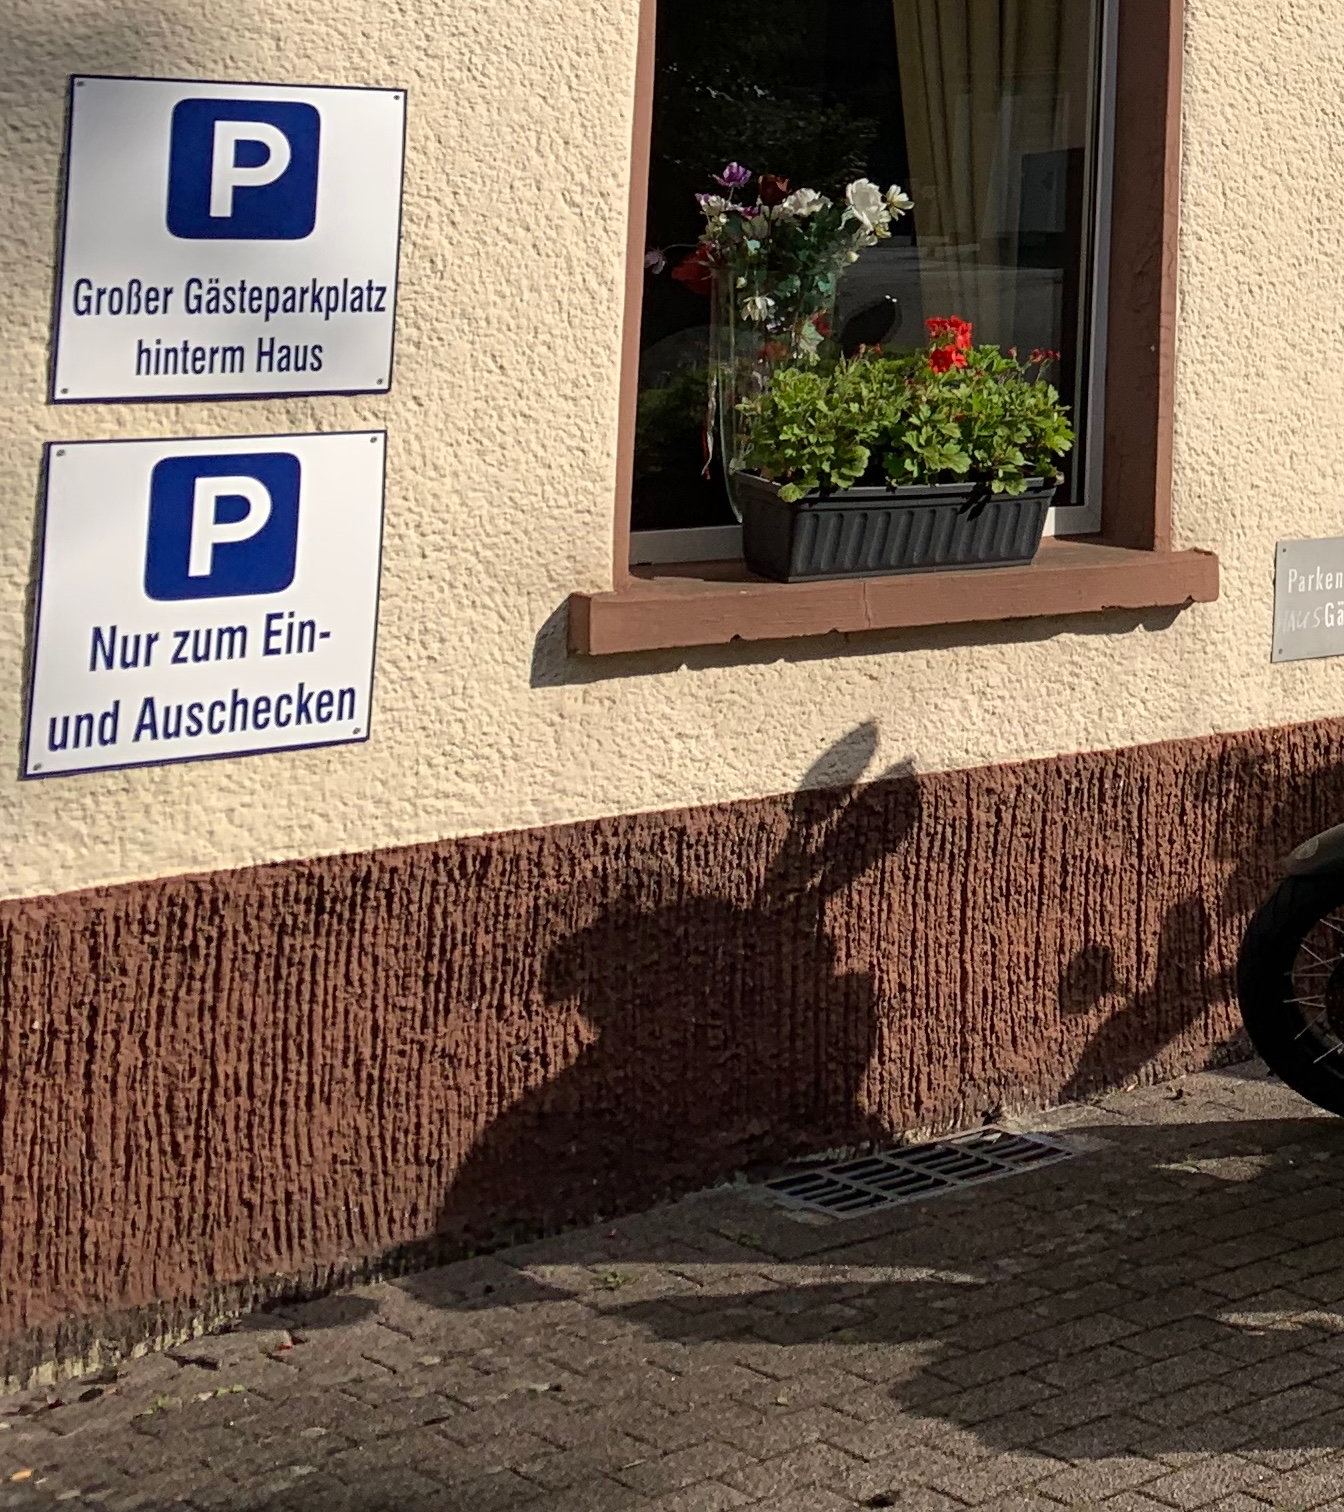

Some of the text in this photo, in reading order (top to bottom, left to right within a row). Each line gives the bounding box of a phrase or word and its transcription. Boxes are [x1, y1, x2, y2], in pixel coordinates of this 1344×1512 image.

[210, 120, 291, 218] P
[73, 277, 387, 320] Großer Gästeparkplatz
[136, 338, 323, 376] hinterm Haus
[188, 476, 271, 578] P
[1288, 565, 1344, 594] Parken
[90, 610, 331, 672] Nur zum Ein-
[48, 682, 357, 751] und Auschecken
